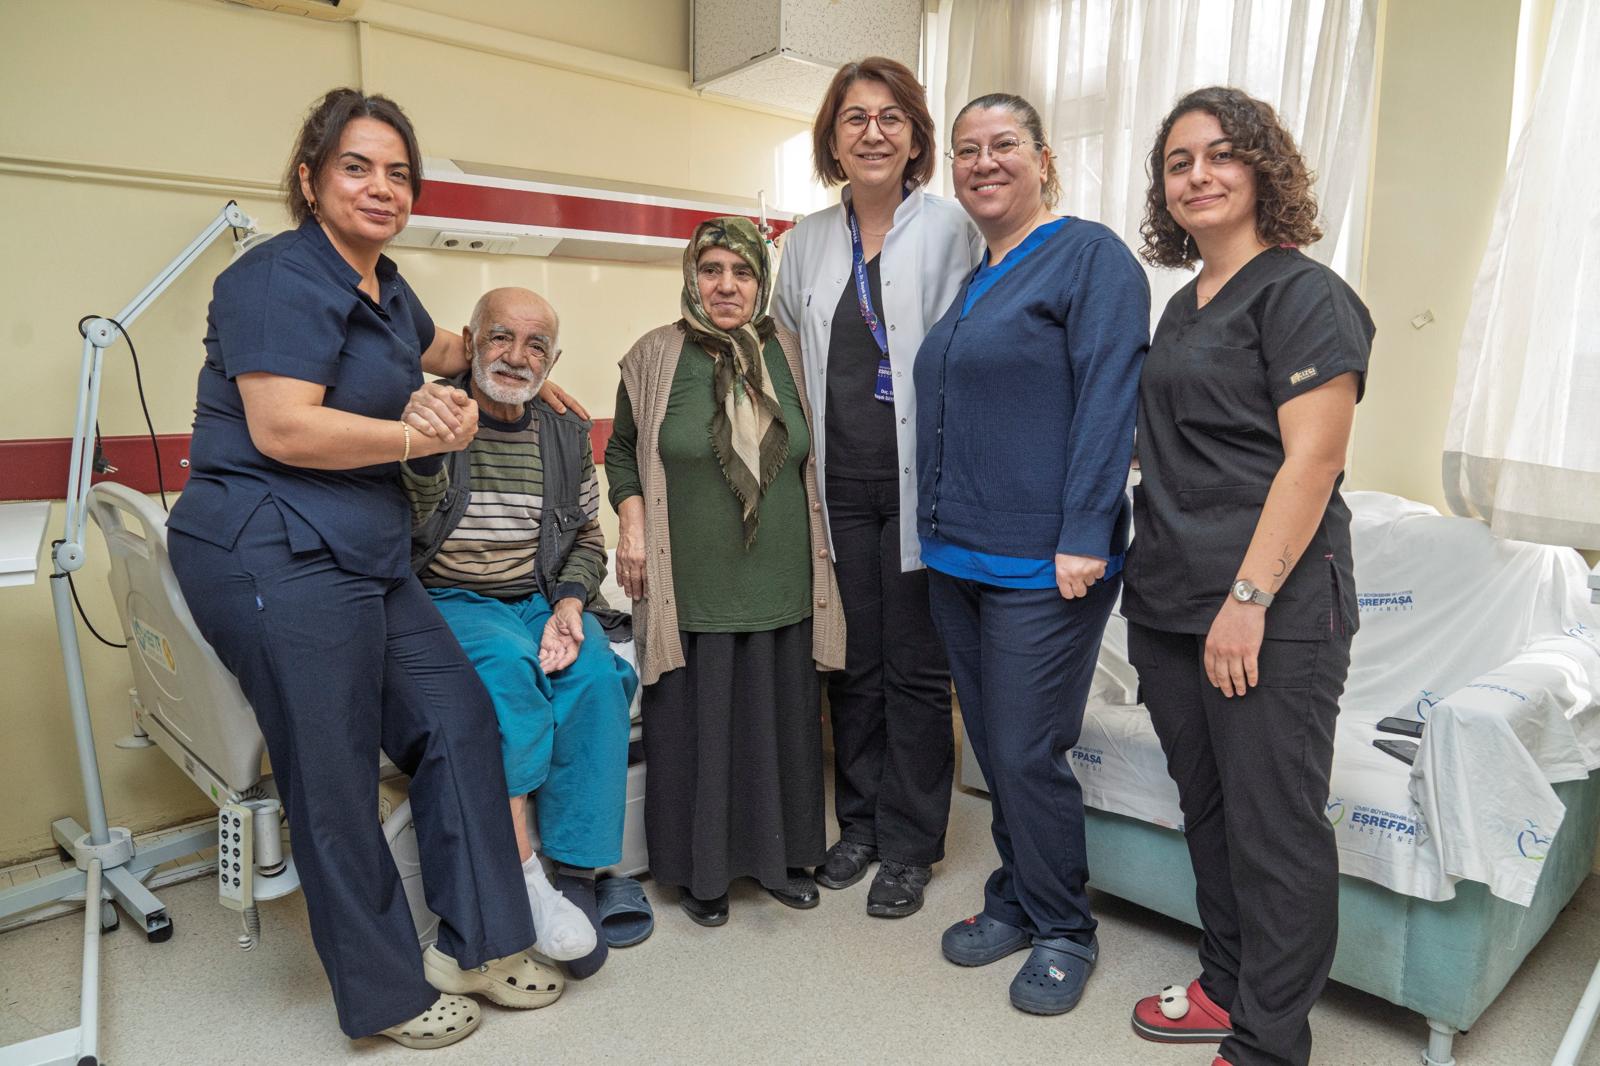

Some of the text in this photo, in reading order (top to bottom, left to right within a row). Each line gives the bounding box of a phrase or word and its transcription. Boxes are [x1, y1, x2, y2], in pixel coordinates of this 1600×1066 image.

[1359, 595, 1413, 608] ŞREFPAŞA
[1072, 750, 1102, 765] FPAŞA
[1351, 811, 1416, 836] EŞREFPA
[1349, 823, 1412, 845] HASTANE
